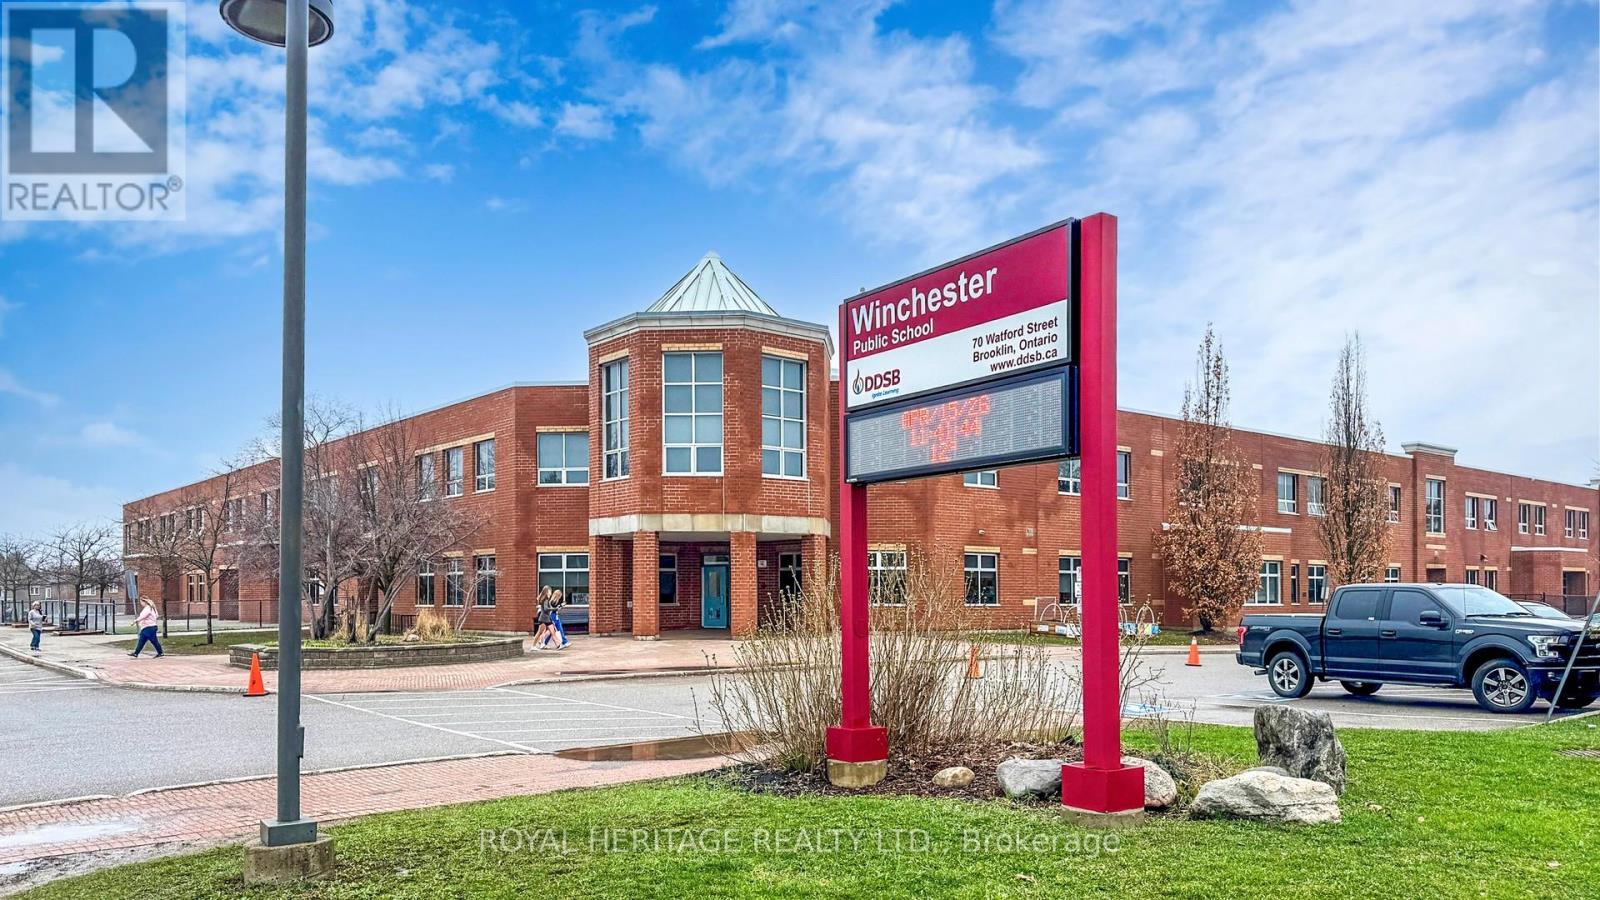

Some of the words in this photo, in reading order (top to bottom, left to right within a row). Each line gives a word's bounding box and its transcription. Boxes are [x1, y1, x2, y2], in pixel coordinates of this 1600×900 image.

[851, 267, 998, 335] Winchester
[853, 335, 889, 356] Public
[891, 317, 934, 345] School
[972, 336, 984, 349] 70
[985, 324, 1024, 346] Watford
[1026, 316, 1059, 335] Street
[972, 343, 1016, 363] Brooklin,
[1019, 332, 1058, 351] Ontario
[990, 348, 1058, 372] www.ddsb.ca
[864, 368, 901, 392] DDSB
